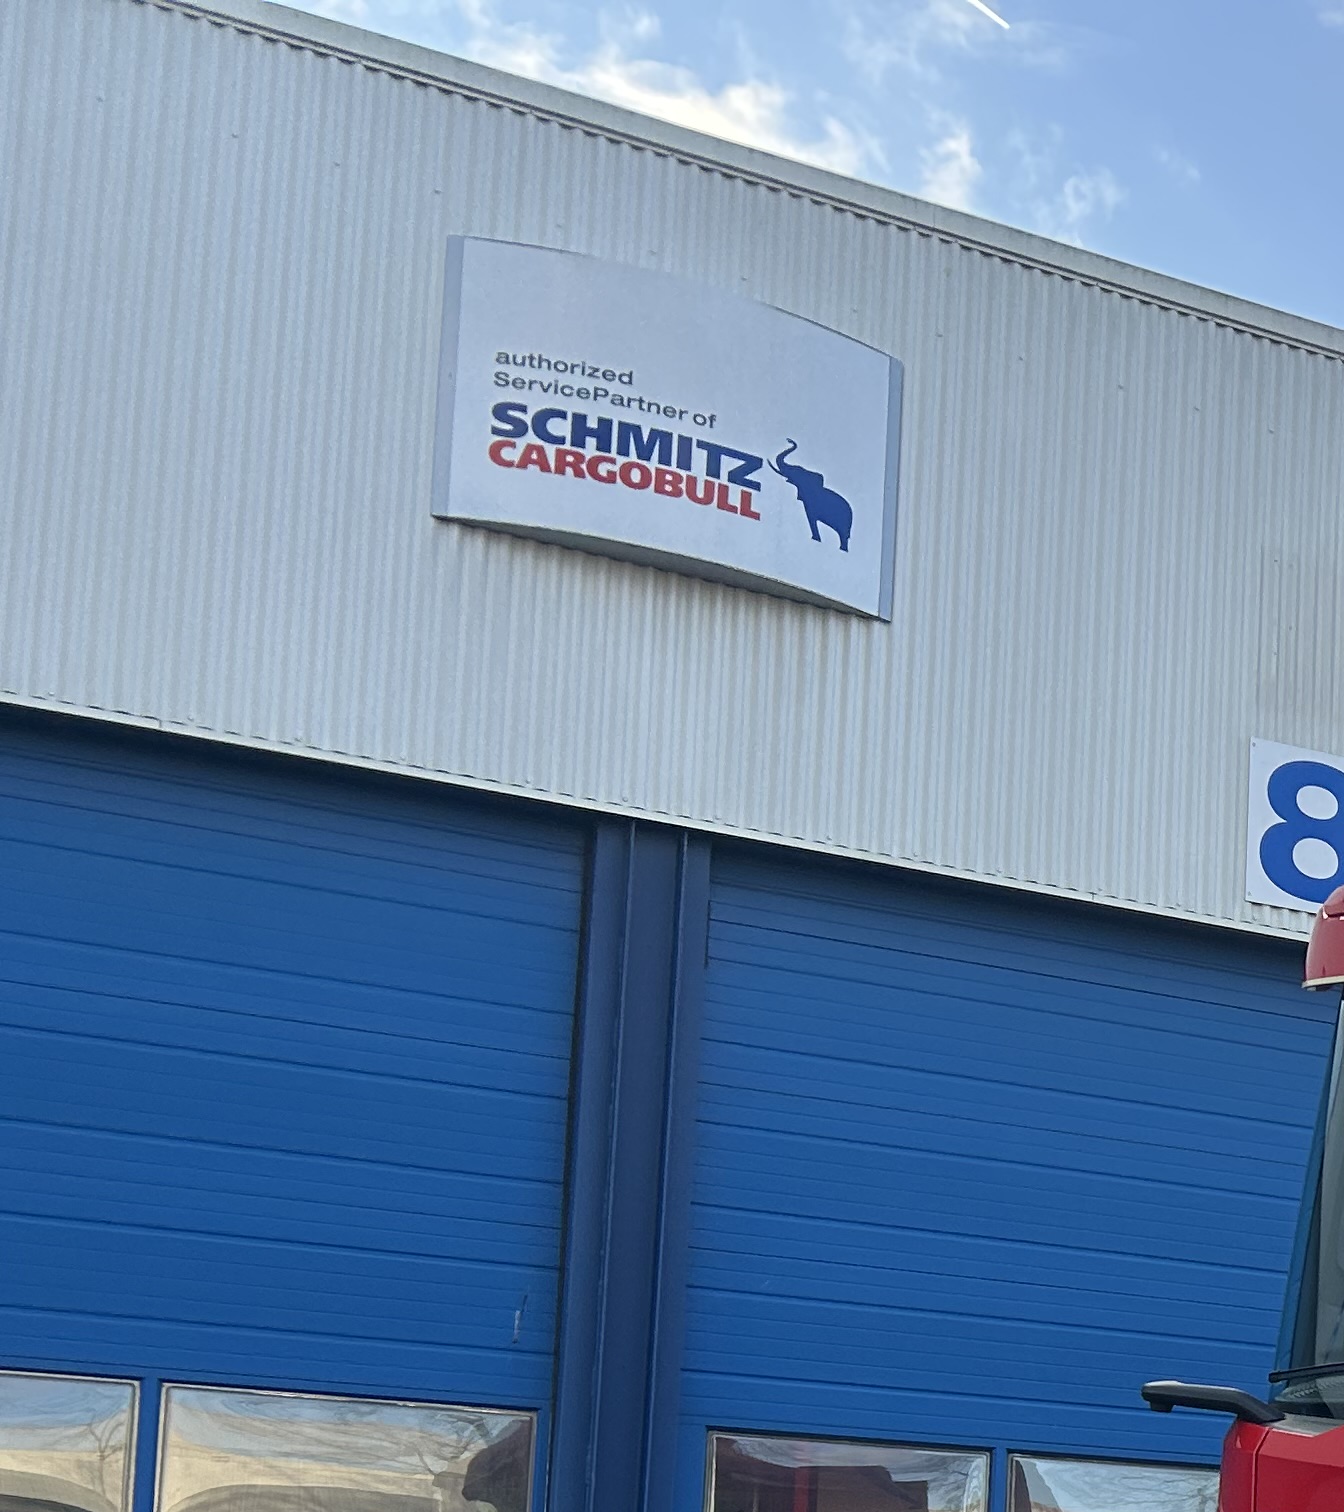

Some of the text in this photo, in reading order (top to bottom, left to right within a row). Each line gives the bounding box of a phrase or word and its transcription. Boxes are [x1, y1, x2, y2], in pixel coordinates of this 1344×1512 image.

[493, 371, 718, 429] ServicePartner of
[495, 349, 634, 387] authorized
[488, 440, 761, 521] CARGOBULL
[490, 401, 764, 492] SCHMITZ
